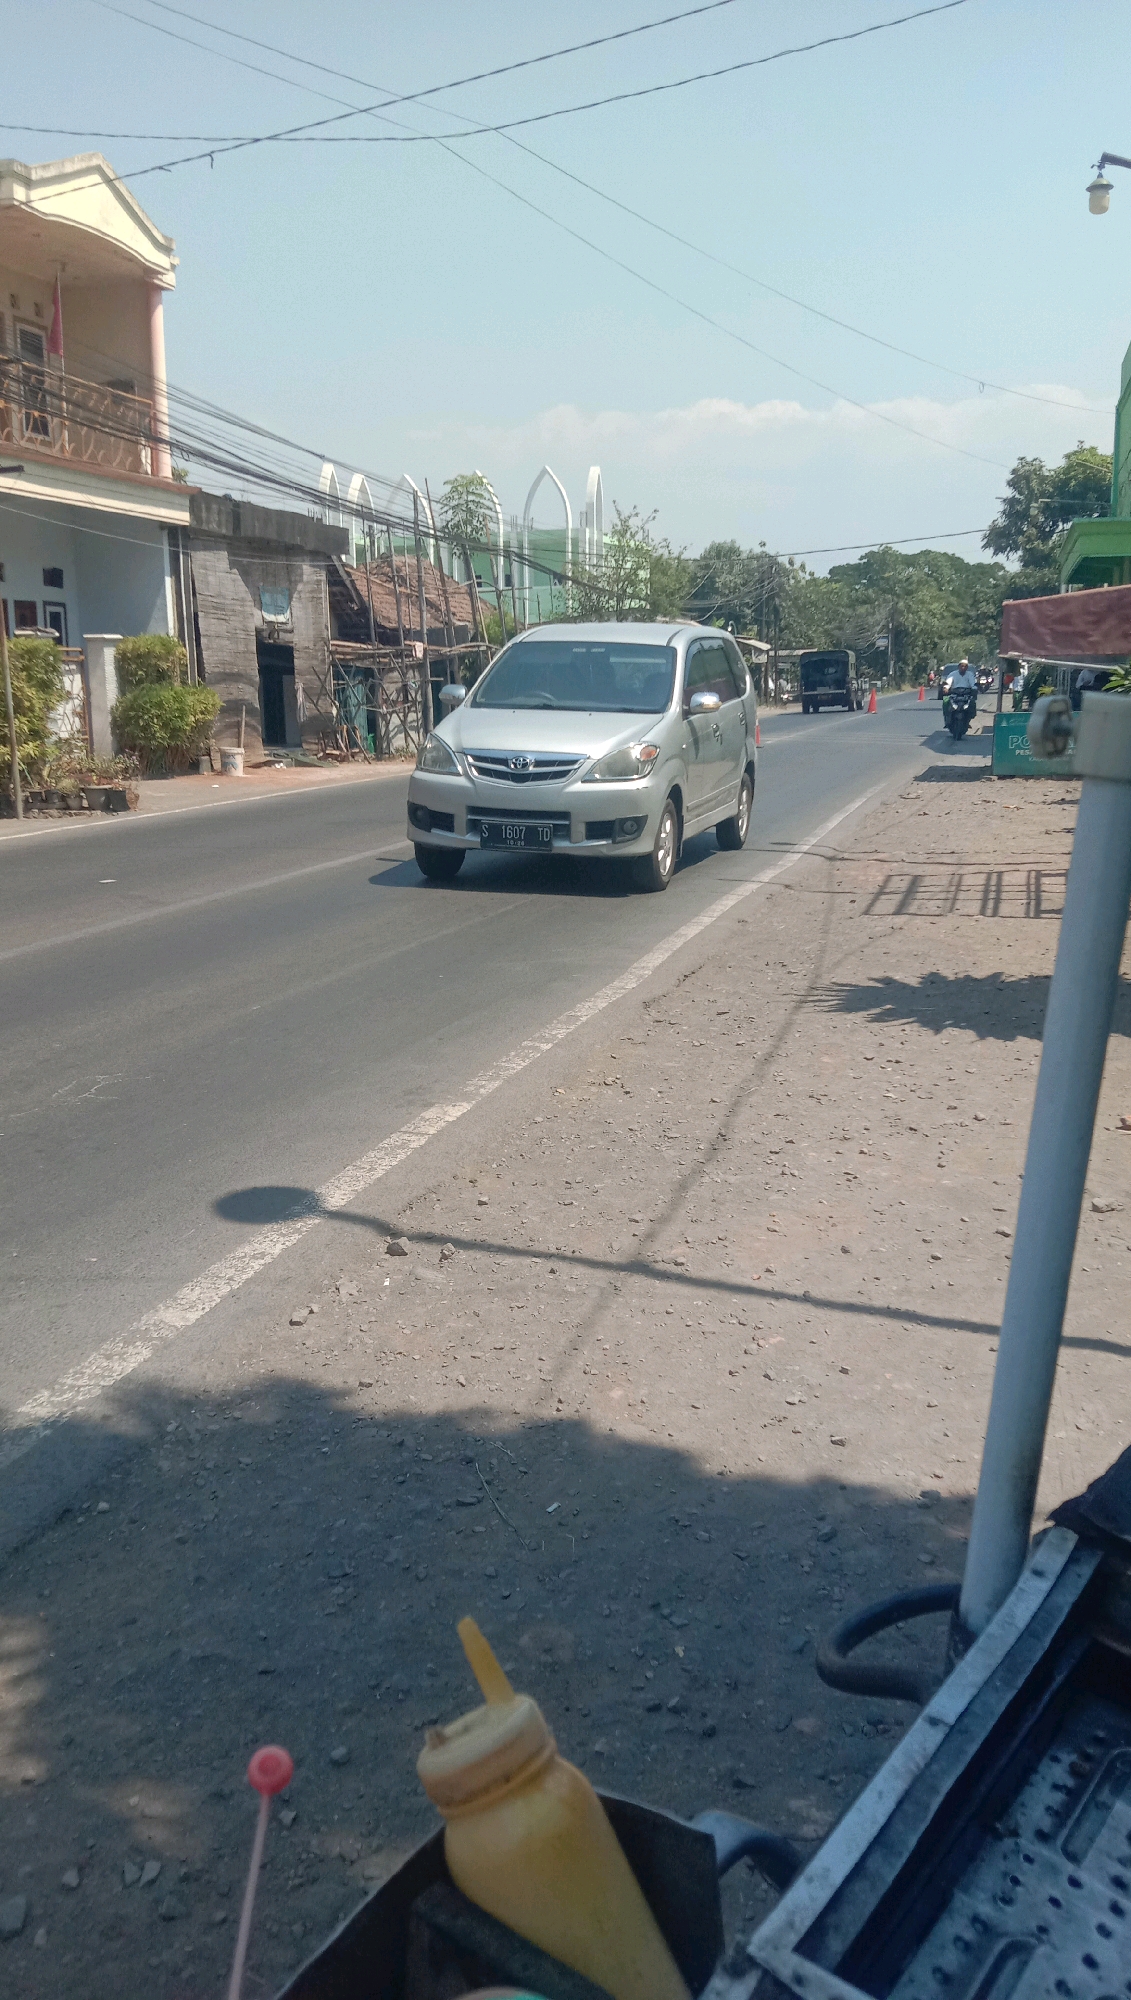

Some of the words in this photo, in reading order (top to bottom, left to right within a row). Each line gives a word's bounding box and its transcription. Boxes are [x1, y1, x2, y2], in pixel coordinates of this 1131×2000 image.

[482, 824, 489, 838] S
[502, 825, 526, 840] 1607
[537, 827, 551, 842] TD
